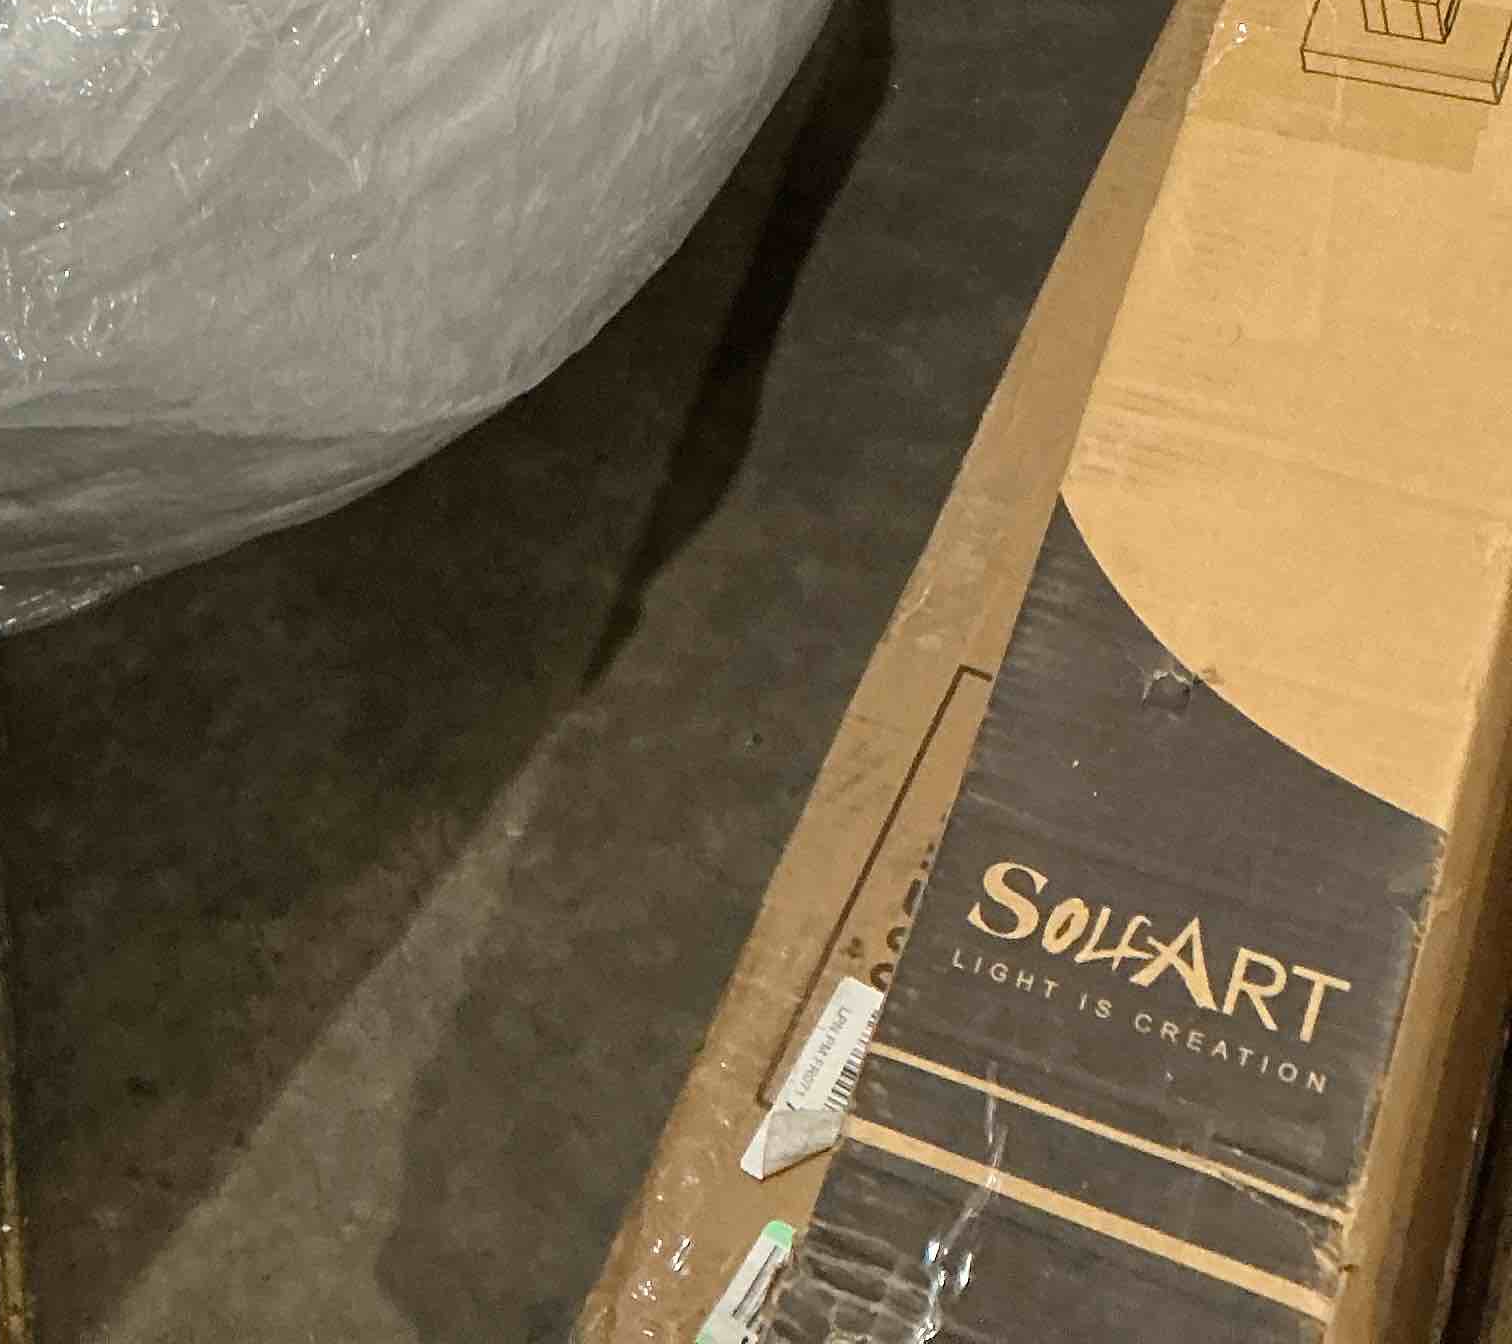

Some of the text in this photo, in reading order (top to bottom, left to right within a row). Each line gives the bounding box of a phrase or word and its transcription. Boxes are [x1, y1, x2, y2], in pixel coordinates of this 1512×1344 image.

[950, 947, 1329, 1095] LIGHT IS CREATION
